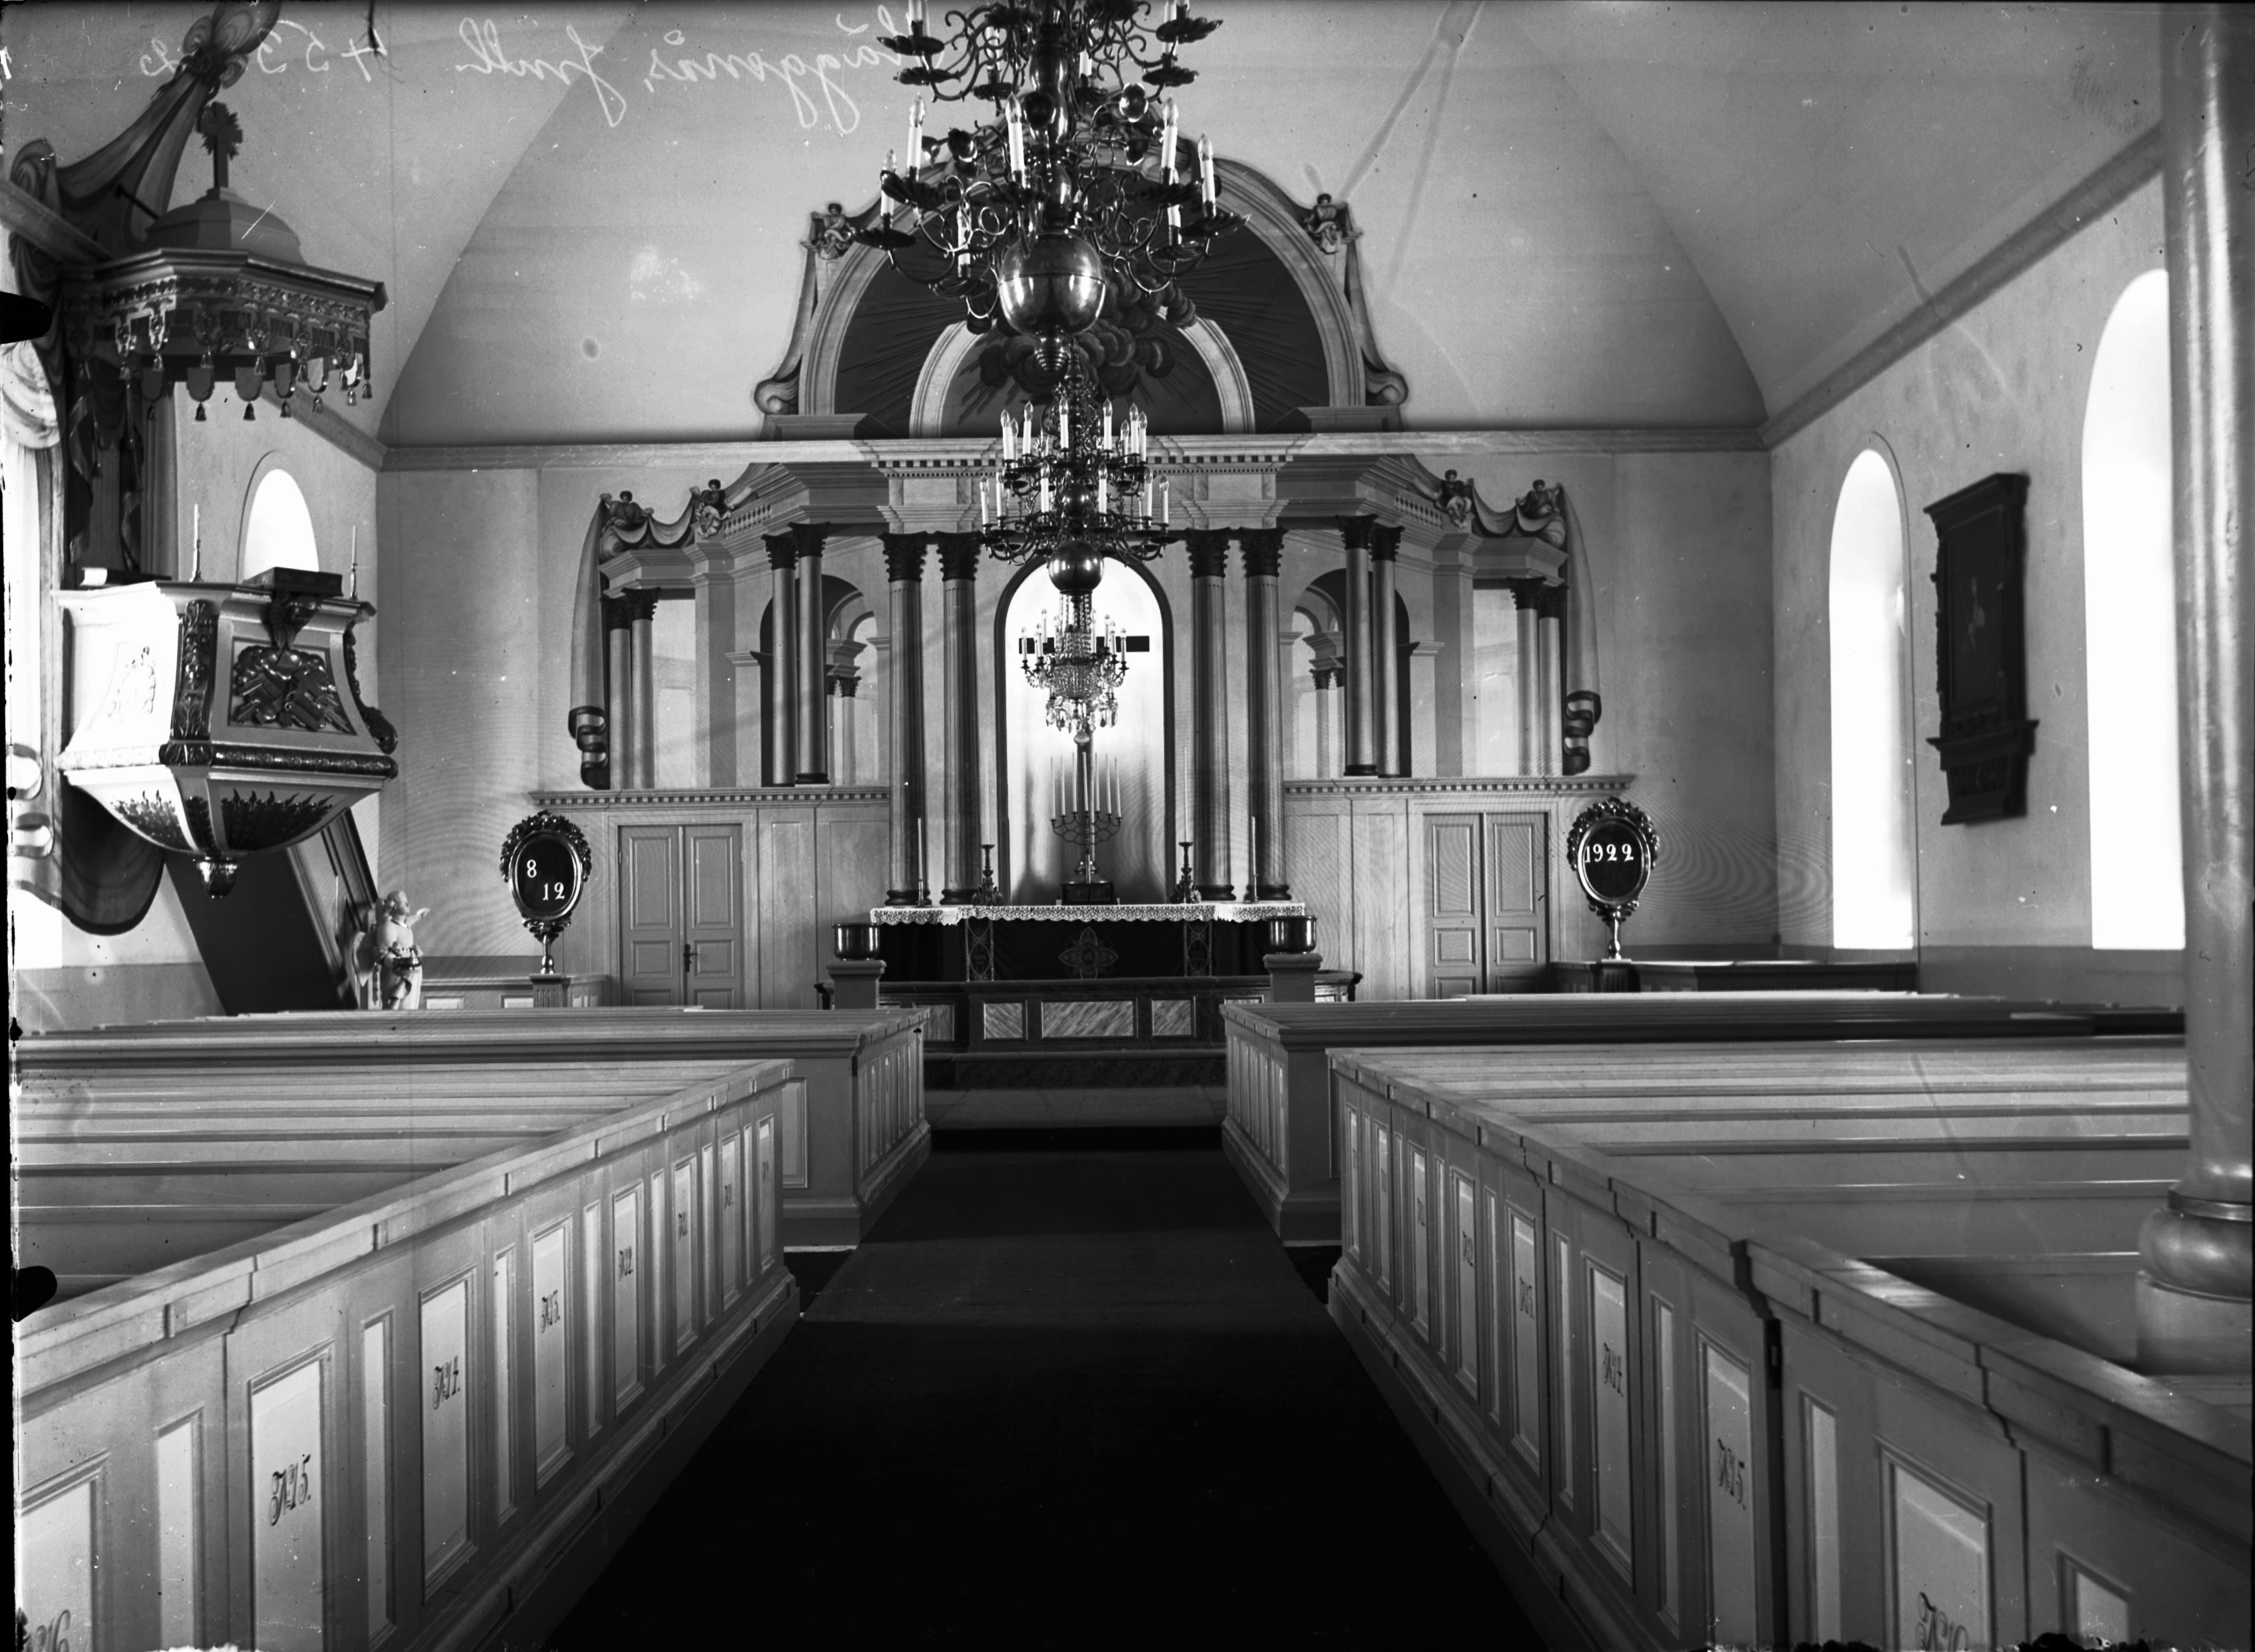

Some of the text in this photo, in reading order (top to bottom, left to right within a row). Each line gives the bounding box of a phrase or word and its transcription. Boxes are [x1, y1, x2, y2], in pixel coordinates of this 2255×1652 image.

[1584, 843, 1634, 863] 1922
[526, 859, 537, 878] 8
[542, 882, 565, 901] 12
